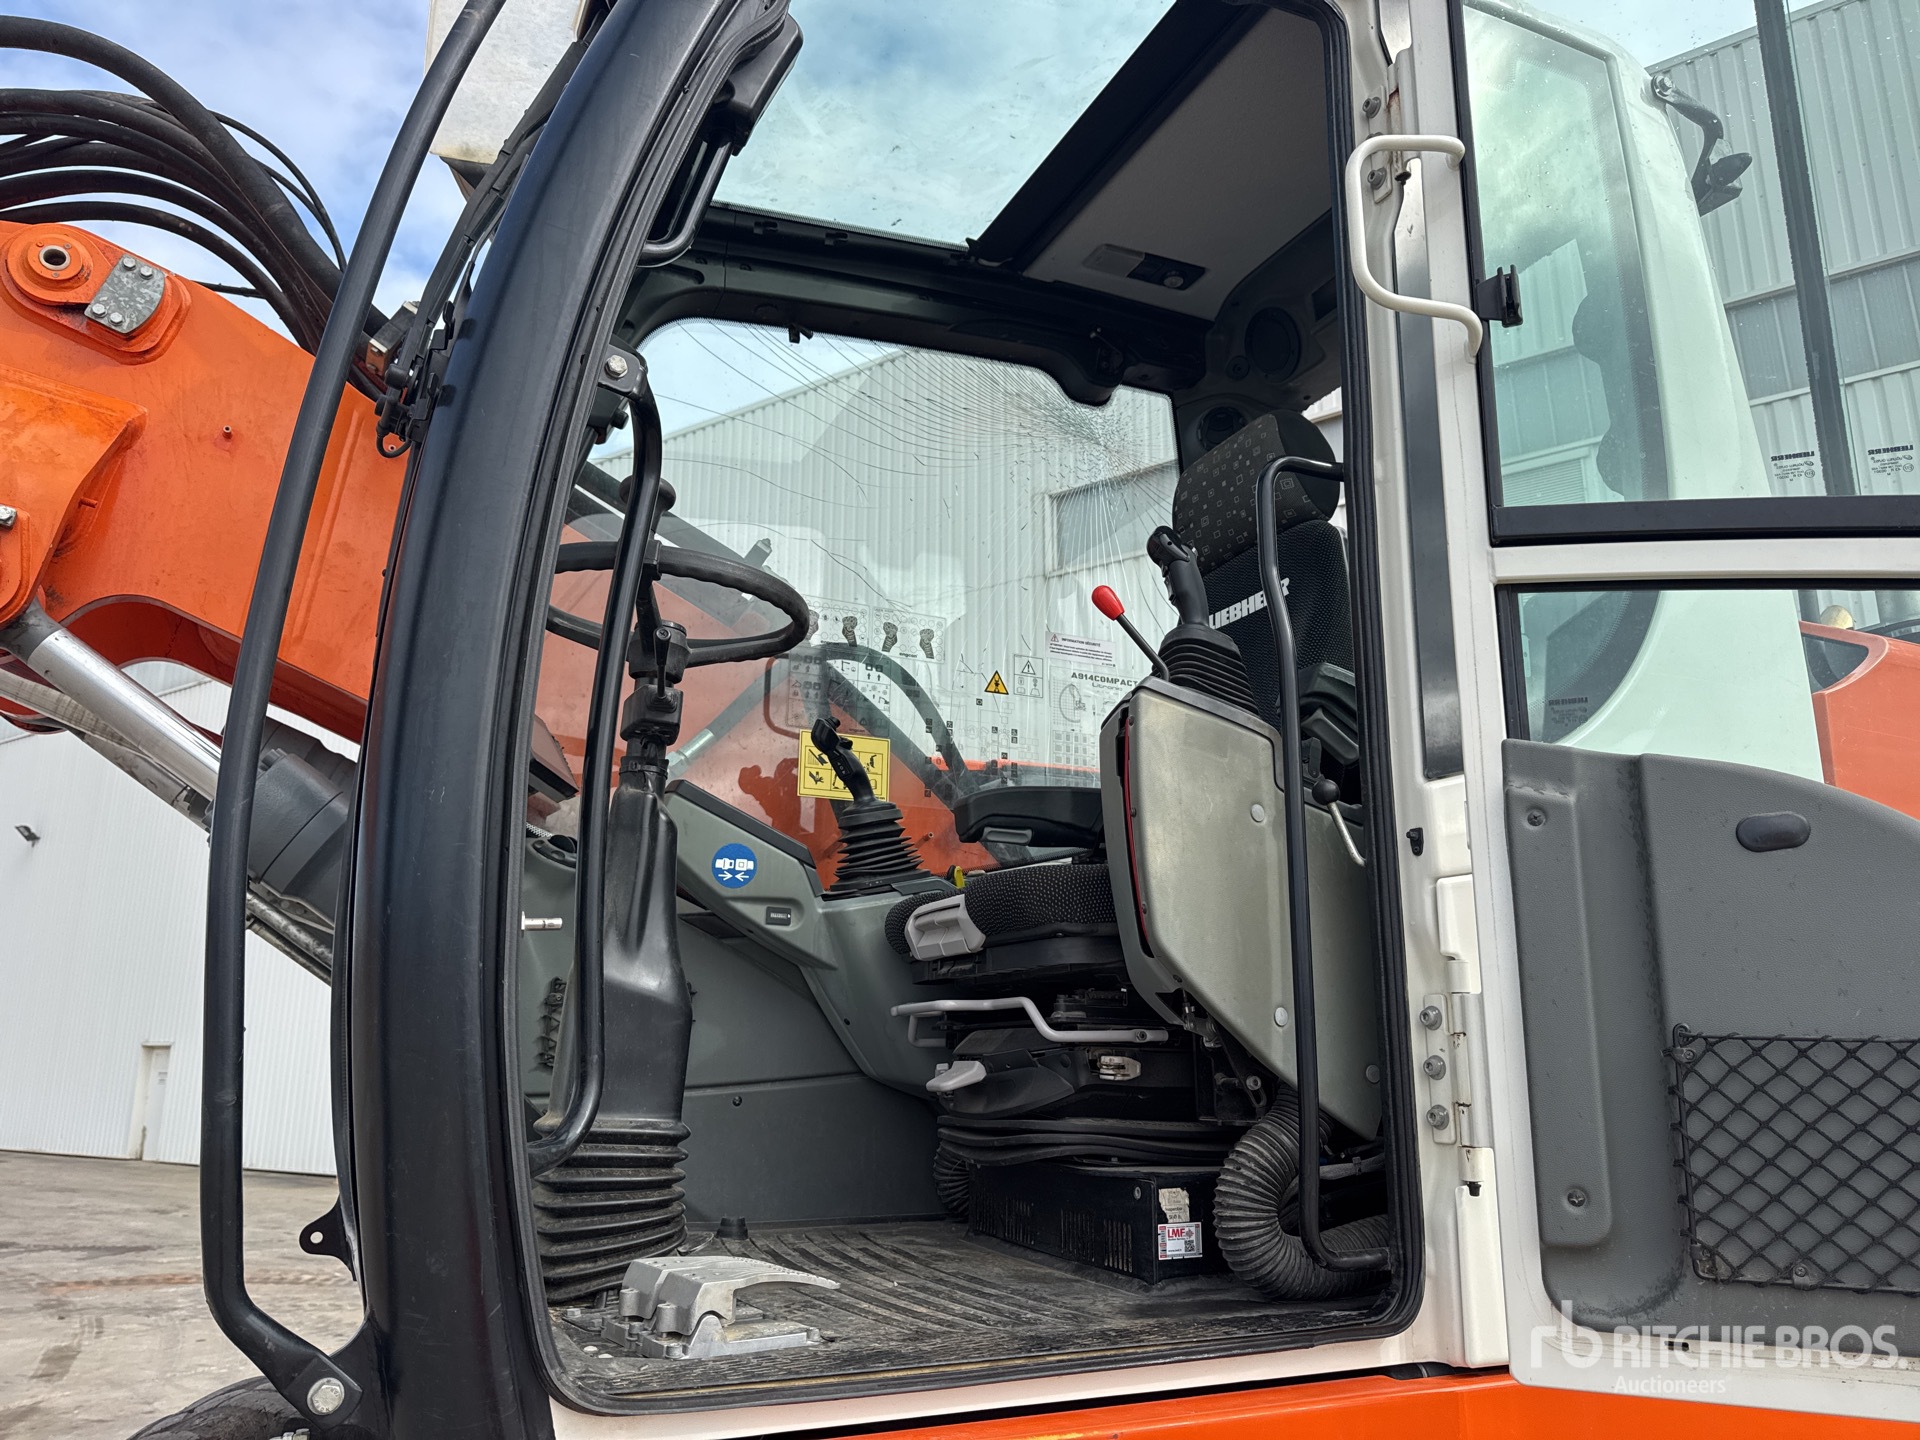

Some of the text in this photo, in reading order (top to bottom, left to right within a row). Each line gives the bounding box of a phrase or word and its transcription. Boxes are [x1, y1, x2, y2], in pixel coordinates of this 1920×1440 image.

[1208, 577, 1290, 630] LIEBHER
[1071, 672, 1138, 687] A914COMPACT
[1168, 1229, 1185, 1238] LMF
